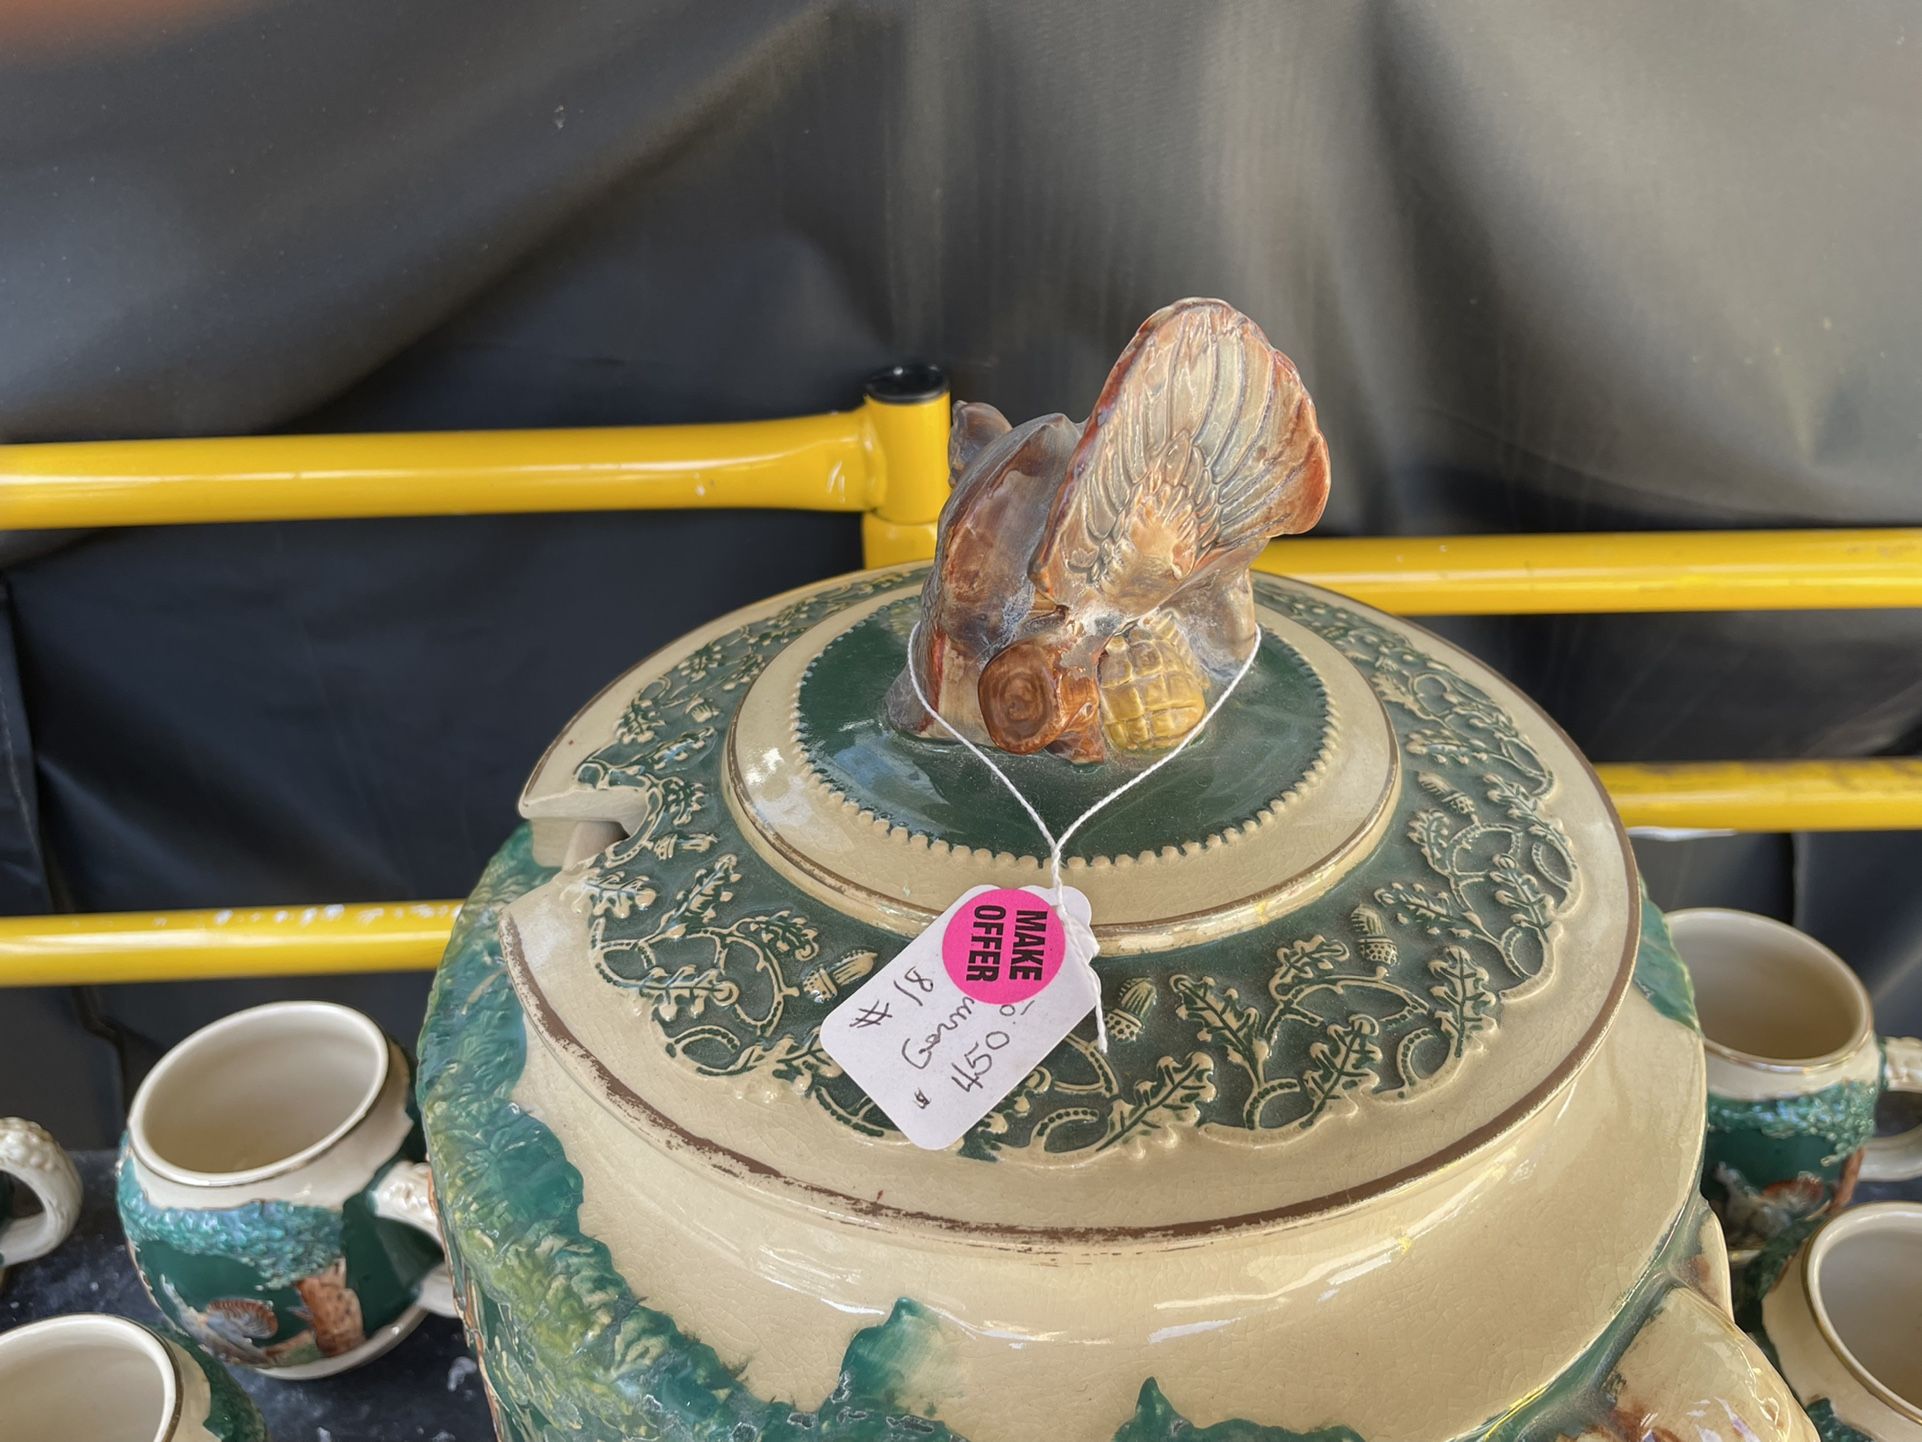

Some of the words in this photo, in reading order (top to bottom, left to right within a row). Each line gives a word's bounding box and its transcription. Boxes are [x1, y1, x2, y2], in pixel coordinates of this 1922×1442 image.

[966, 905, 1006, 982] OFFER
[1009, 910, 1048, 982] MAKE
[894, 966, 934, 1007] 18
[901, 996, 975, 1069] Germ
